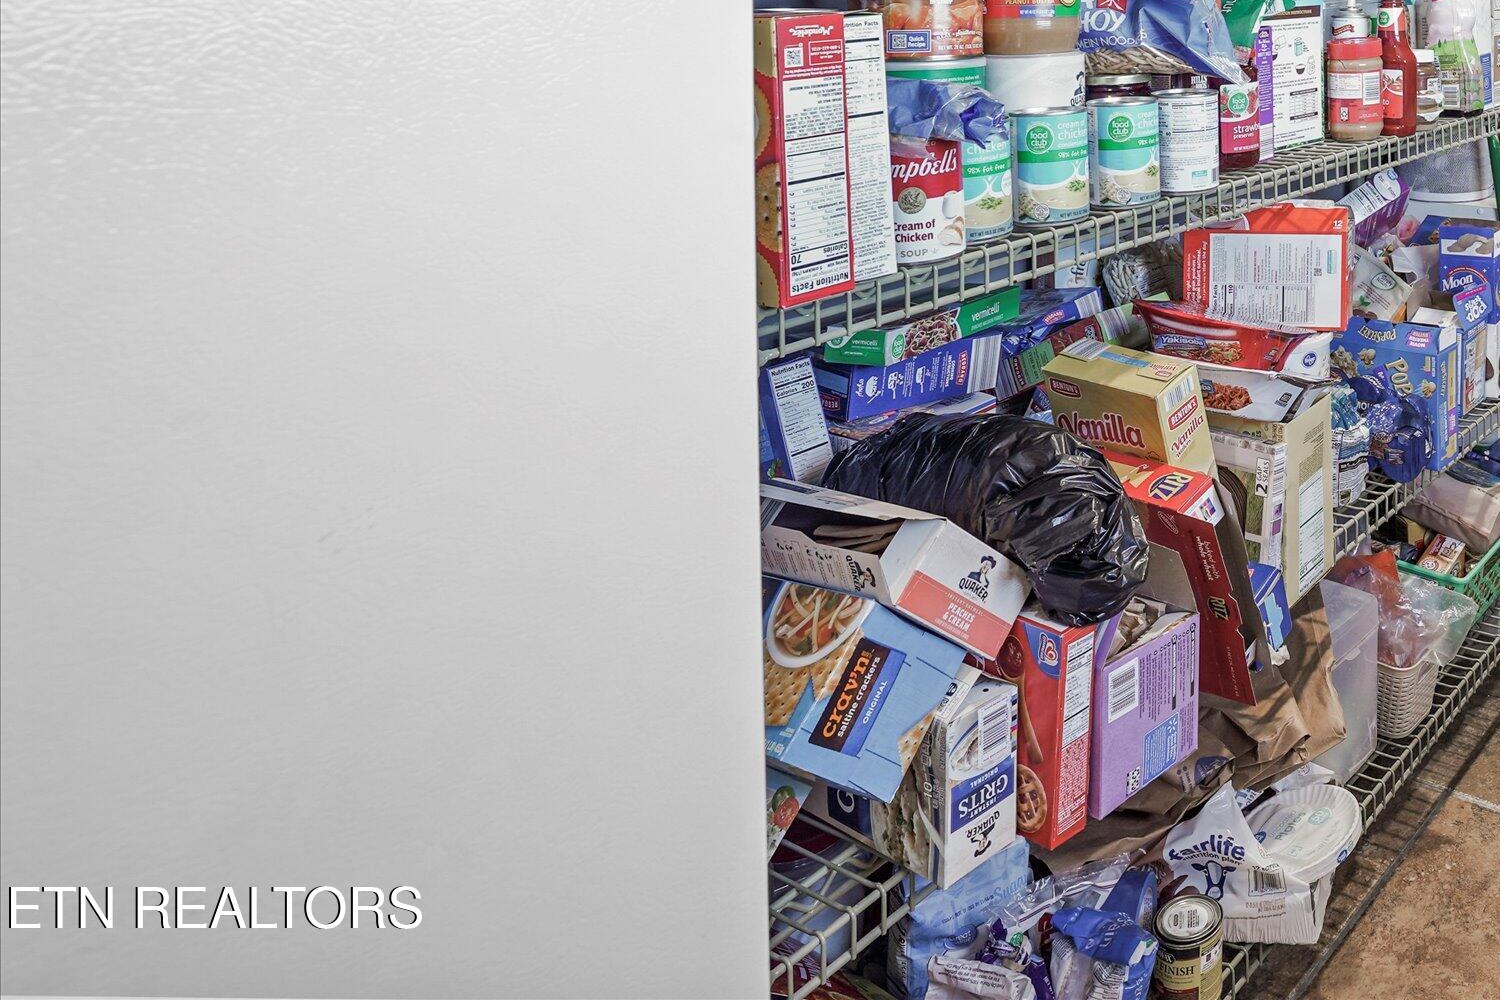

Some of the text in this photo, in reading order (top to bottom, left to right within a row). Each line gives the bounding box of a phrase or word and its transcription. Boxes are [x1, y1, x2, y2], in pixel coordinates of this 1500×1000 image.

[1191, 75, 1208, 84] HILLS
[1057, 120, 1076, 129] cream
[1112, 121, 1129, 130] food
[1112, 129, 1129, 138] club
[1030, 139, 1047, 147] club
[1031, 130, 1047, 139] food
[1234, 132, 1255, 140] preserves
[1058, 149, 1080, 158] 98% fat
[892, 148, 958, 184] mpbell's
[967, 163, 1006, 175] 98% fat free
[894, 218, 936, 233] Cream of
[1333, 219, 1343, 227] 12
[895, 231, 934, 243] Chicken
[823, 243, 848, 254] Calories
[900, 248, 929, 259] SOUP
[791, 254, 802, 265] 70
[792, 272, 849, 293] Nutrition Facts
[1442, 274, 1473, 292] Moon
[971, 302, 1001, 322] vermicelli
[1162, 336, 1204, 346] Yakisoba
[771, 360, 811, 377] Nutrition Facts
[959, 354, 968, 382] REGGANO
[776, 380, 815, 398] Calories 200
[1052, 380, 1079, 394] BENTON'S
[1171, 398, 1197, 424] BENTON'S
[1058, 411, 1146, 448] Vanilla
[1171, 415, 1204, 452] Vanilla
[1148, 471, 1194, 501] RITZ
[1256, 483, 1268, 495] 2
[1196, 536, 1214, 581] whole wheat
[1204, 541, 1220, 579] baked with
[845, 555, 861, 592] QUAKER
[959, 577, 988, 602] QUAKER
[948, 602, 975, 623] PEACHES
[1207, 595, 1229, 620] RITZ
[949, 614, 971, 632] CREAM
[822, 652, 869, 738] crav'n
[838, 656, 881, 738] saltine crackers
[862, 680, 888, 725] ORIGINAL
[969, 766, 998, 788] ORIGINAL
[958, 773, 1008, 819] GRITS
[969, 796, 997, 818] INSTANT
[966, 811, 1000, 838] QUAKER
[1168, 834, 1246, 861] fairlife
[1183, 850, 1219, 861] nutrition
